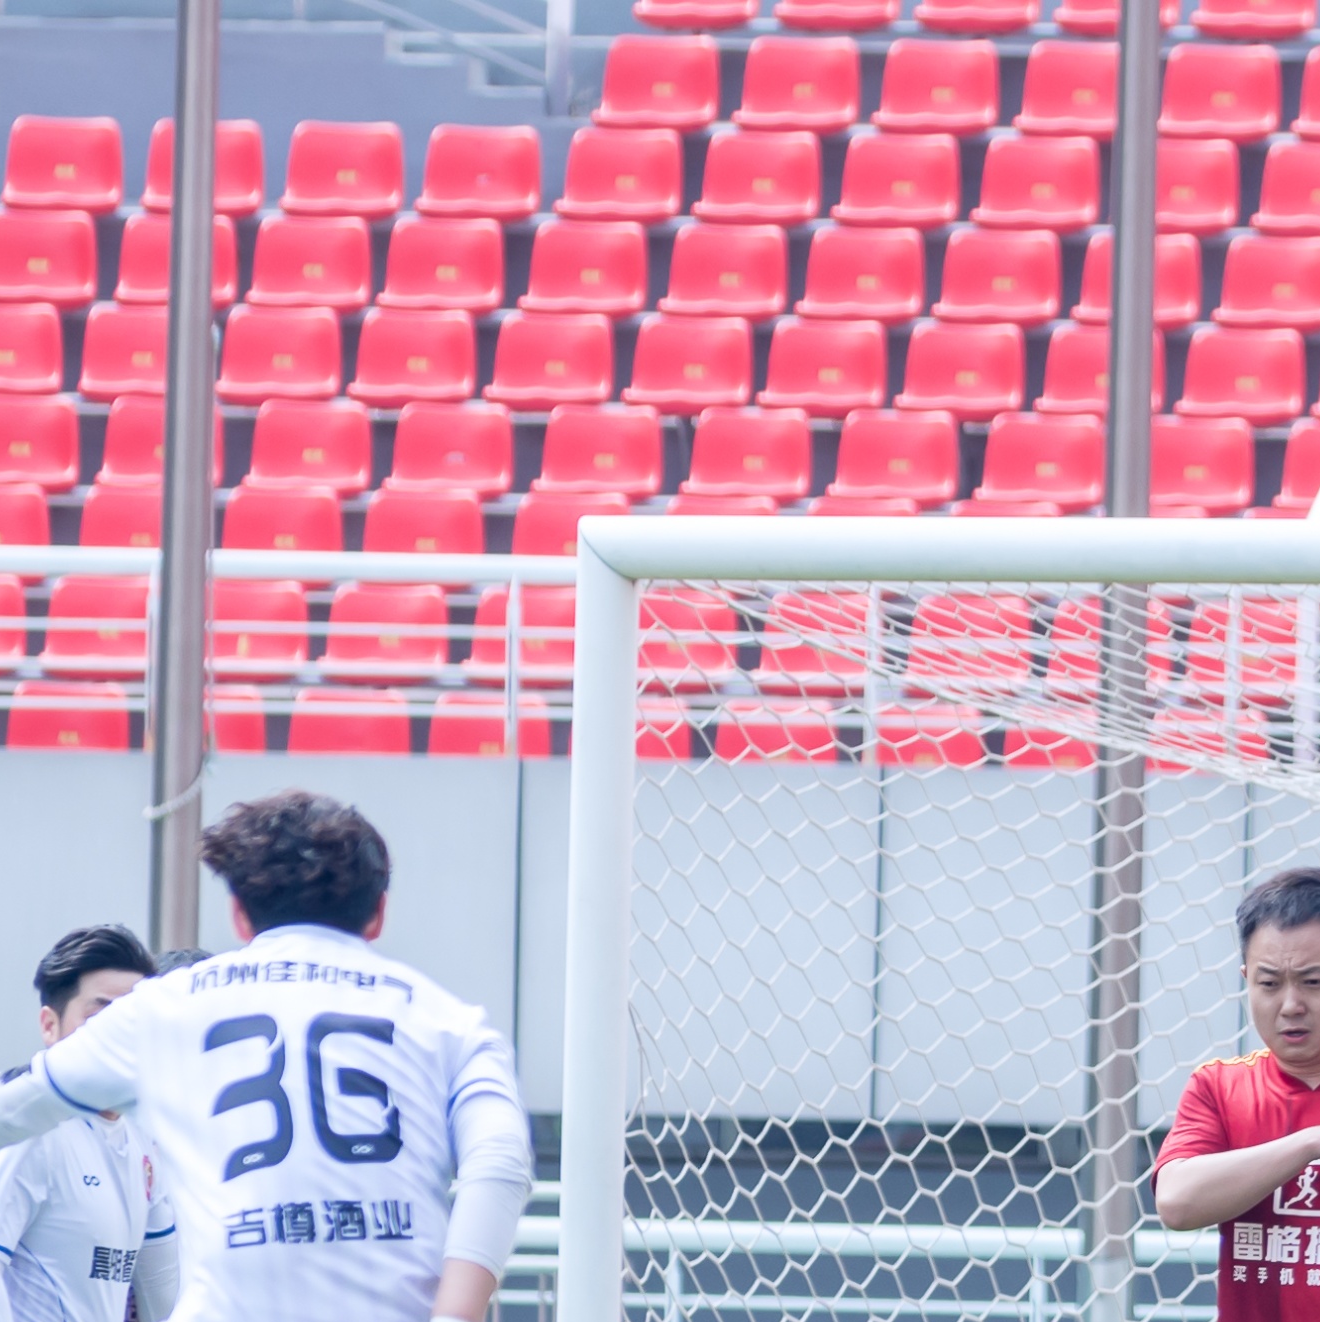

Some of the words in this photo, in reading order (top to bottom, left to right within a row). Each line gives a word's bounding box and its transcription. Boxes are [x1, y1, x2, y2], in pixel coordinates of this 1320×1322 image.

[203, 1012, 403, 1182] 36
[224, 1199, 414, 1249] 吉樽酒业
